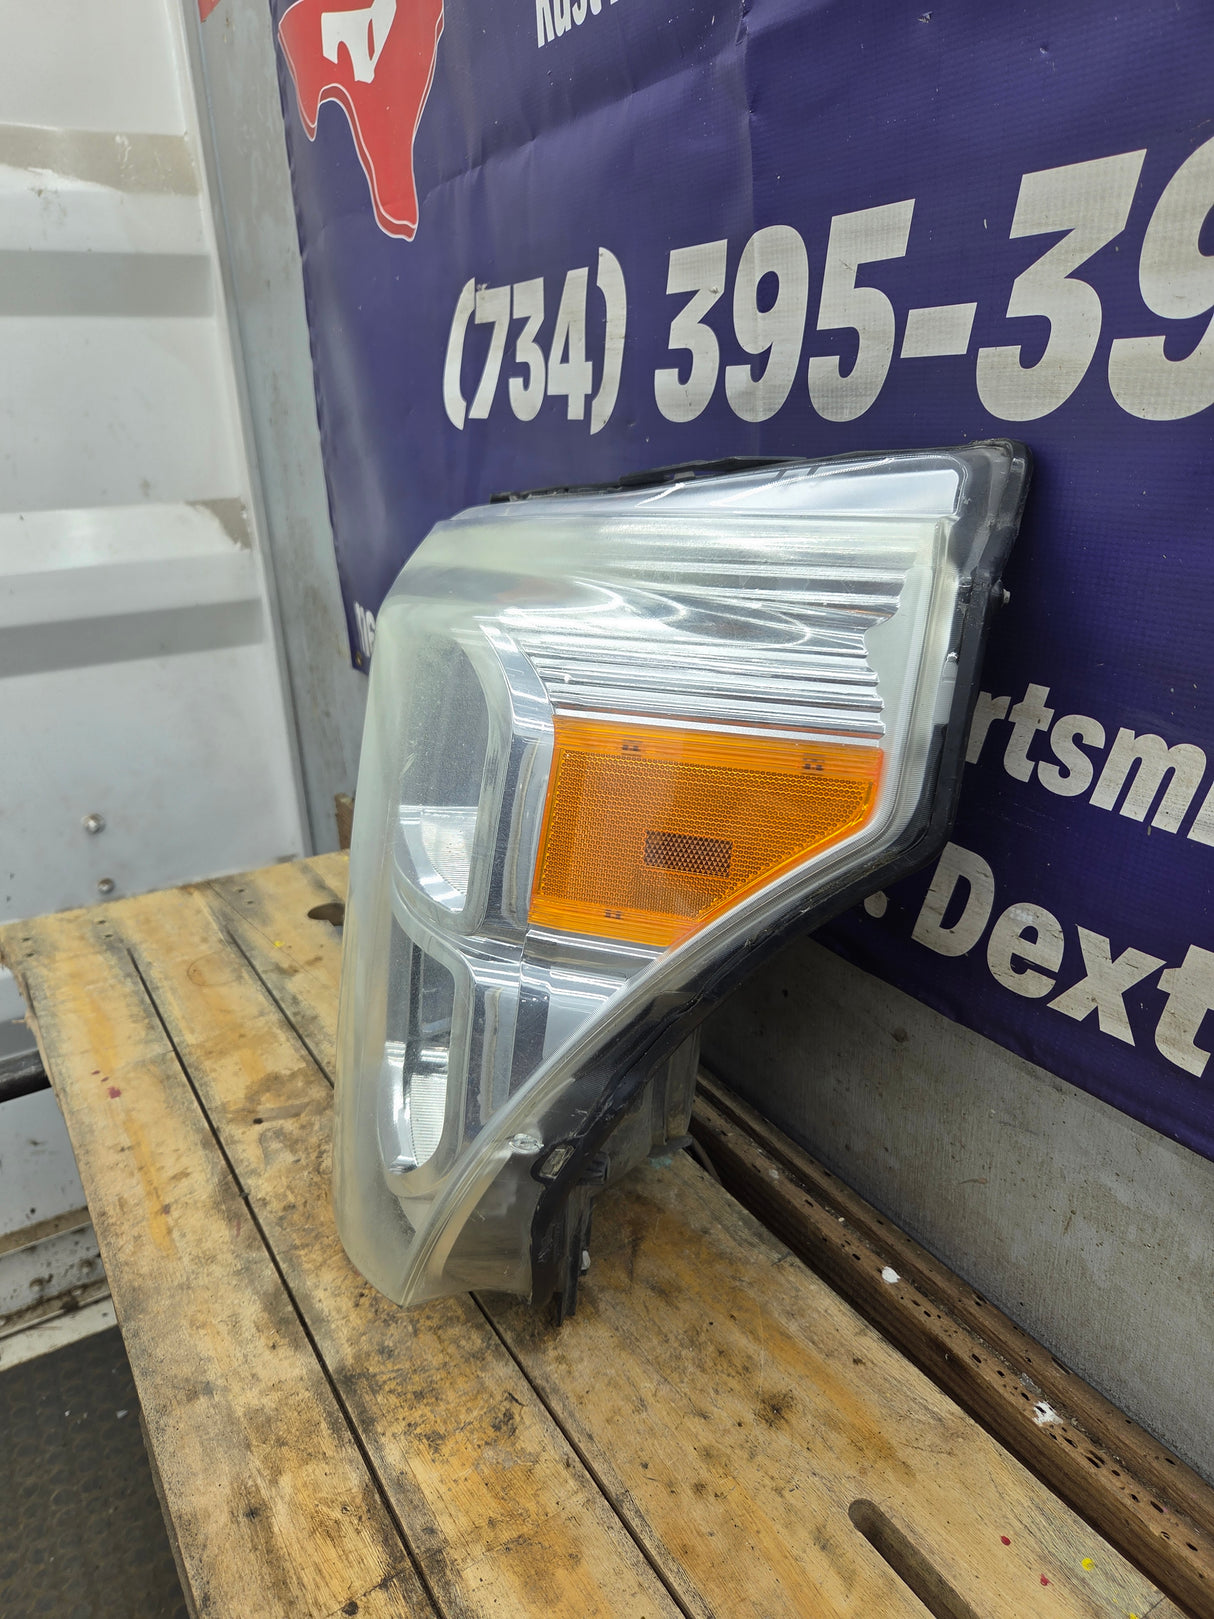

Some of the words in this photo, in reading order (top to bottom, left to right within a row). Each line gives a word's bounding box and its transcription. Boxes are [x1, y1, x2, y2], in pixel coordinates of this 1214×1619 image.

[443, 247, 627, 435] (734)
[655, 136, 1214, 422] 395-39
[965, 683, 1214, 847] rtsm
